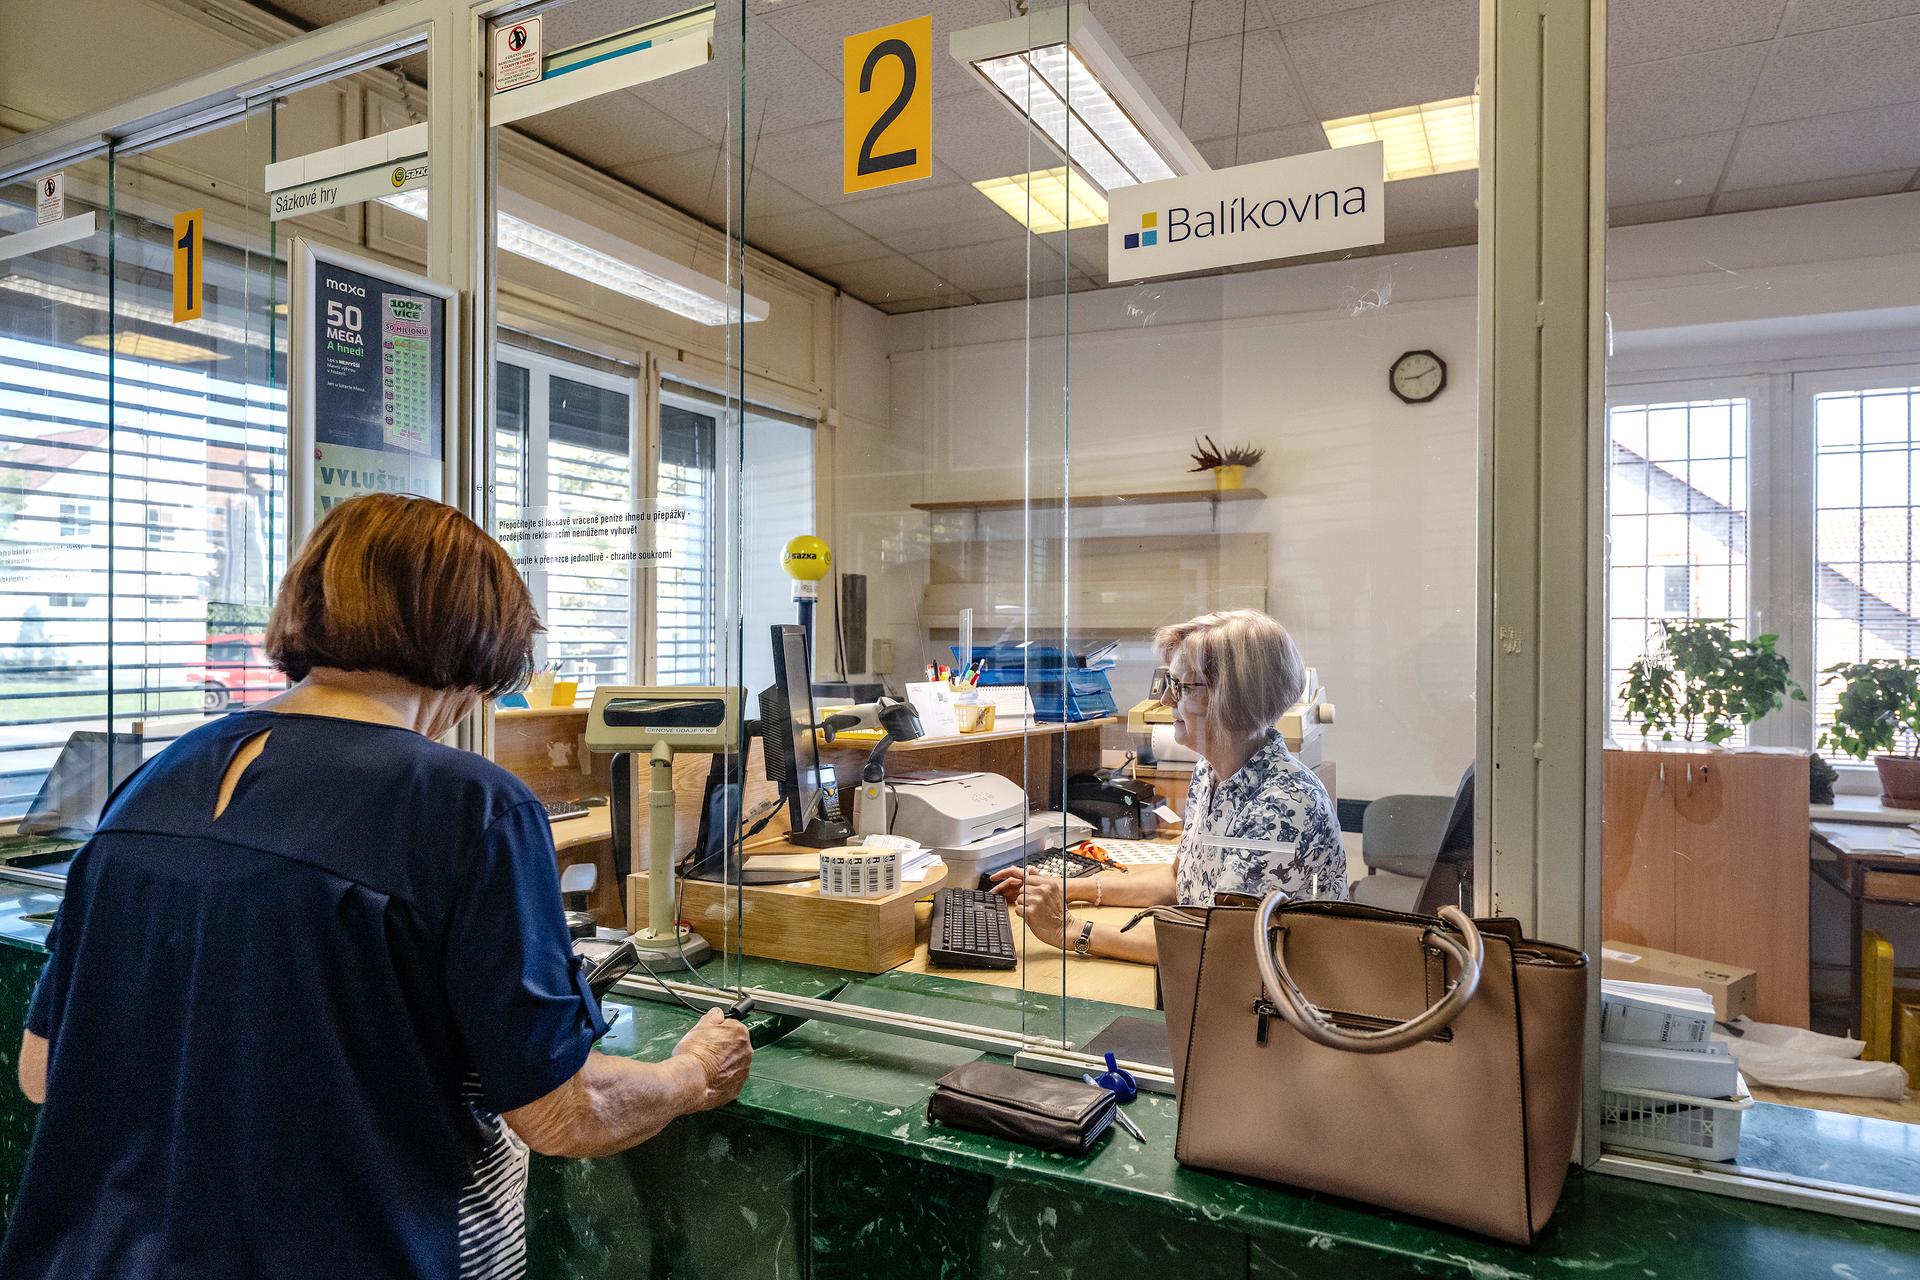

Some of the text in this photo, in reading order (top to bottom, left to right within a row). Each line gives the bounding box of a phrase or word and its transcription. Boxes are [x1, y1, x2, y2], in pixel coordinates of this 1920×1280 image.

[857, 38, 918, 177] 2
[405, 166, 429, 180] sazk
[275, 187, 338, 213] Sázkové hry
[1168, 185, 1365, 243] Balíkovna
[177, 220, 195, 311] 1
[326, 278, 366, 298] maxa
[327, 299, 362, 332] 50
[392, 308, 420, 319] VÍCE
[326, 326, 364, 346] MEGA
[385, 323, 395, 331] 50
[327, 340, 364, 357] A hned!
[320, 466, 406, 491] VYLUŠTI
[499, 519, 537, 531] Přepočítejte
[537, 518, 544, 527] si
[545, 517, 571, 527] laskavě
[572, 515, 599, 525] vrácené
[600, 513, 623, 525] peníze
[625, 511, 645, 522] ihned
[646, 513, 652, 521] u
[653, 509, 686, 522] přepážky
[498, 531, 531, 543] pozdějším
[572, 526, 609, 538] nemůžeme
[610, 525, 638, 537] vyhovět
[534, 555, 539, 564] k
[570, 552, 604, 565] jednotlivě
[610, 551, 637, 561] chraňte
[638, 548, 673, 560] soukromí
[791, 552, 817, 560] sazka
[837, 857, 845, 865] R
[854, 857, 863, 865] R
[872, 856, 881, 864] R
